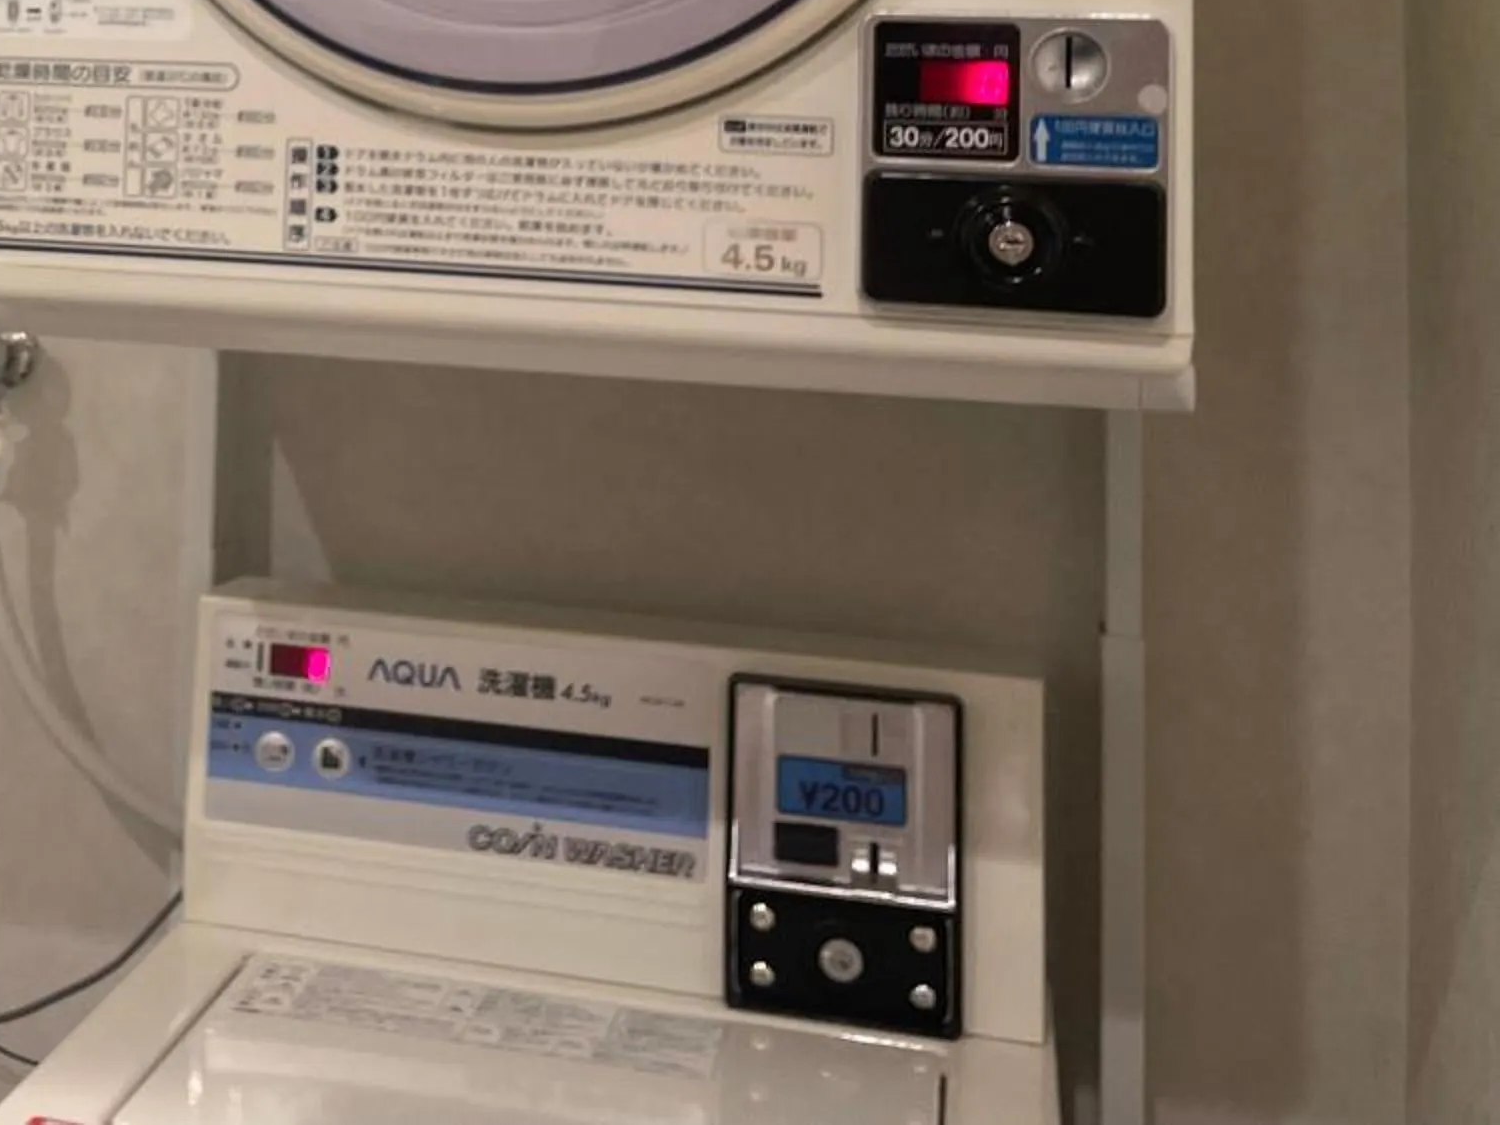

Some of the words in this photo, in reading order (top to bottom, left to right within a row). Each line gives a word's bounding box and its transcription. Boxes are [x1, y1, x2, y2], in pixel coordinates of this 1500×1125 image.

[720, 243, 776, 272] 4.5
[780, 255, 808, 278] kg
[366, 658, 462, 691] AQUA
[477, 667, 557, 701] 洗濯機
[799, 780, 886, 818] ¥200
[563, 836, 697, 879] WASHER
